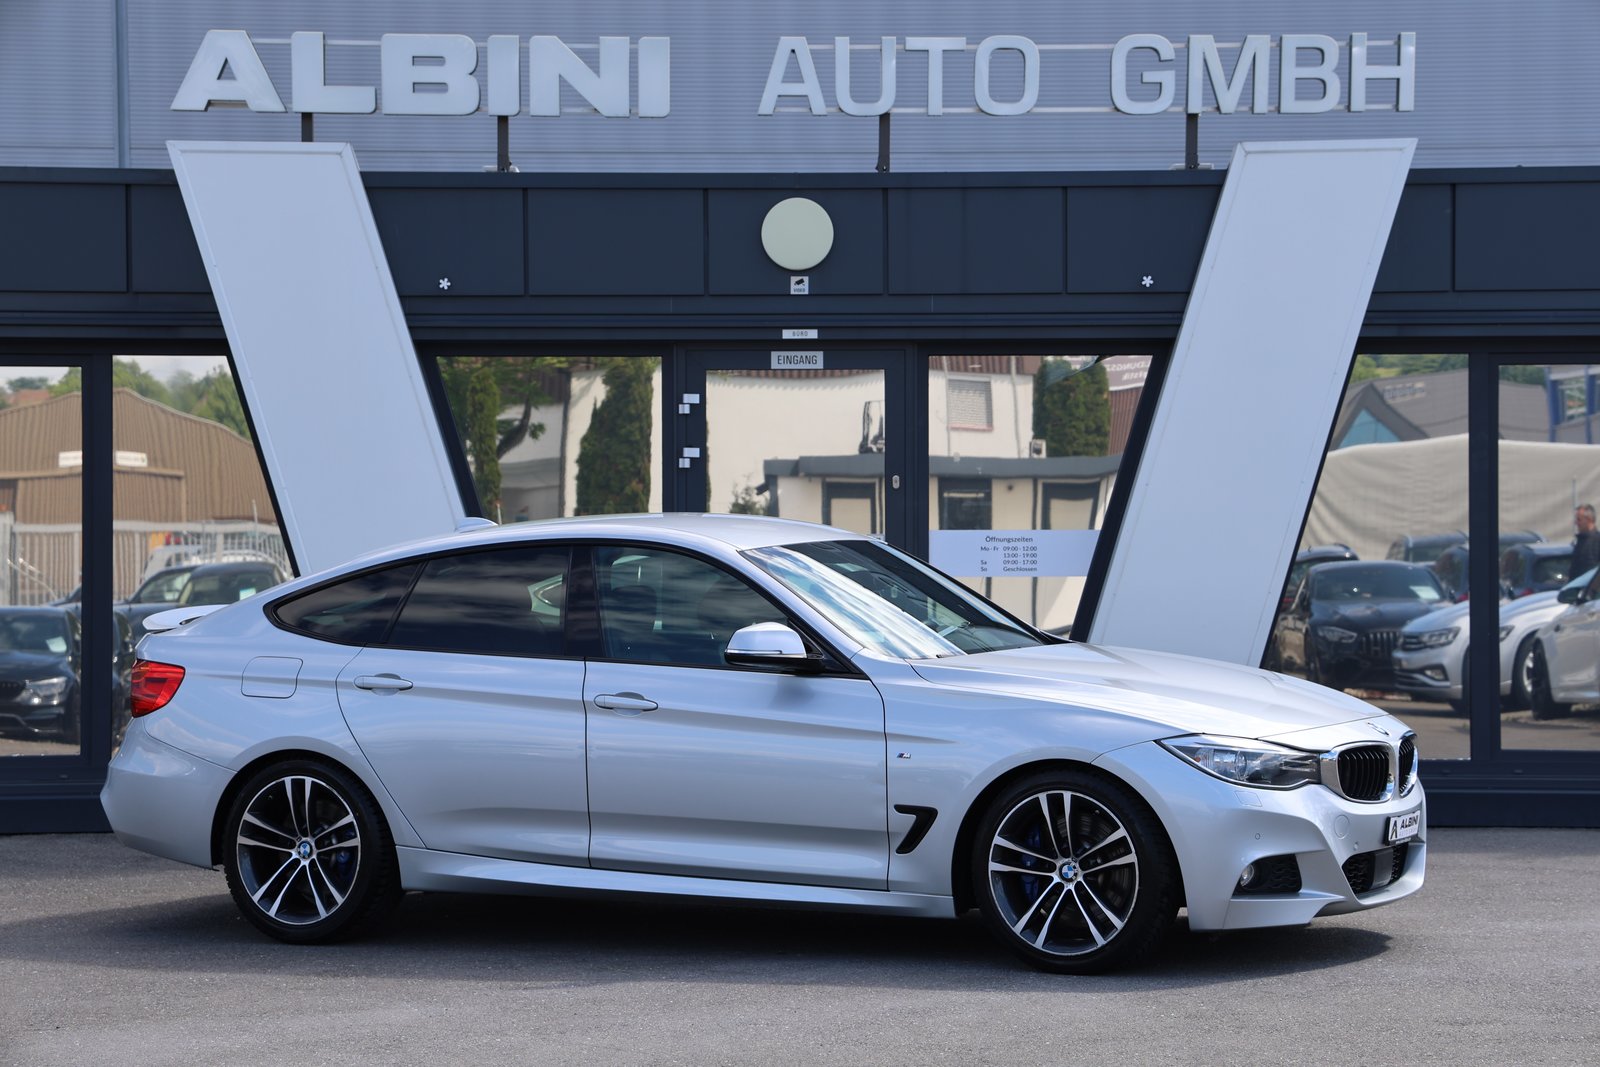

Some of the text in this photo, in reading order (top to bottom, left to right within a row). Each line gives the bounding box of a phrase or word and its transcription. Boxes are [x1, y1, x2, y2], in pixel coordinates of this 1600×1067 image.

[170, 29, 1416, 118] ALBINI AUTO GMBH
[777, 355, 818, 365] EINGANG
